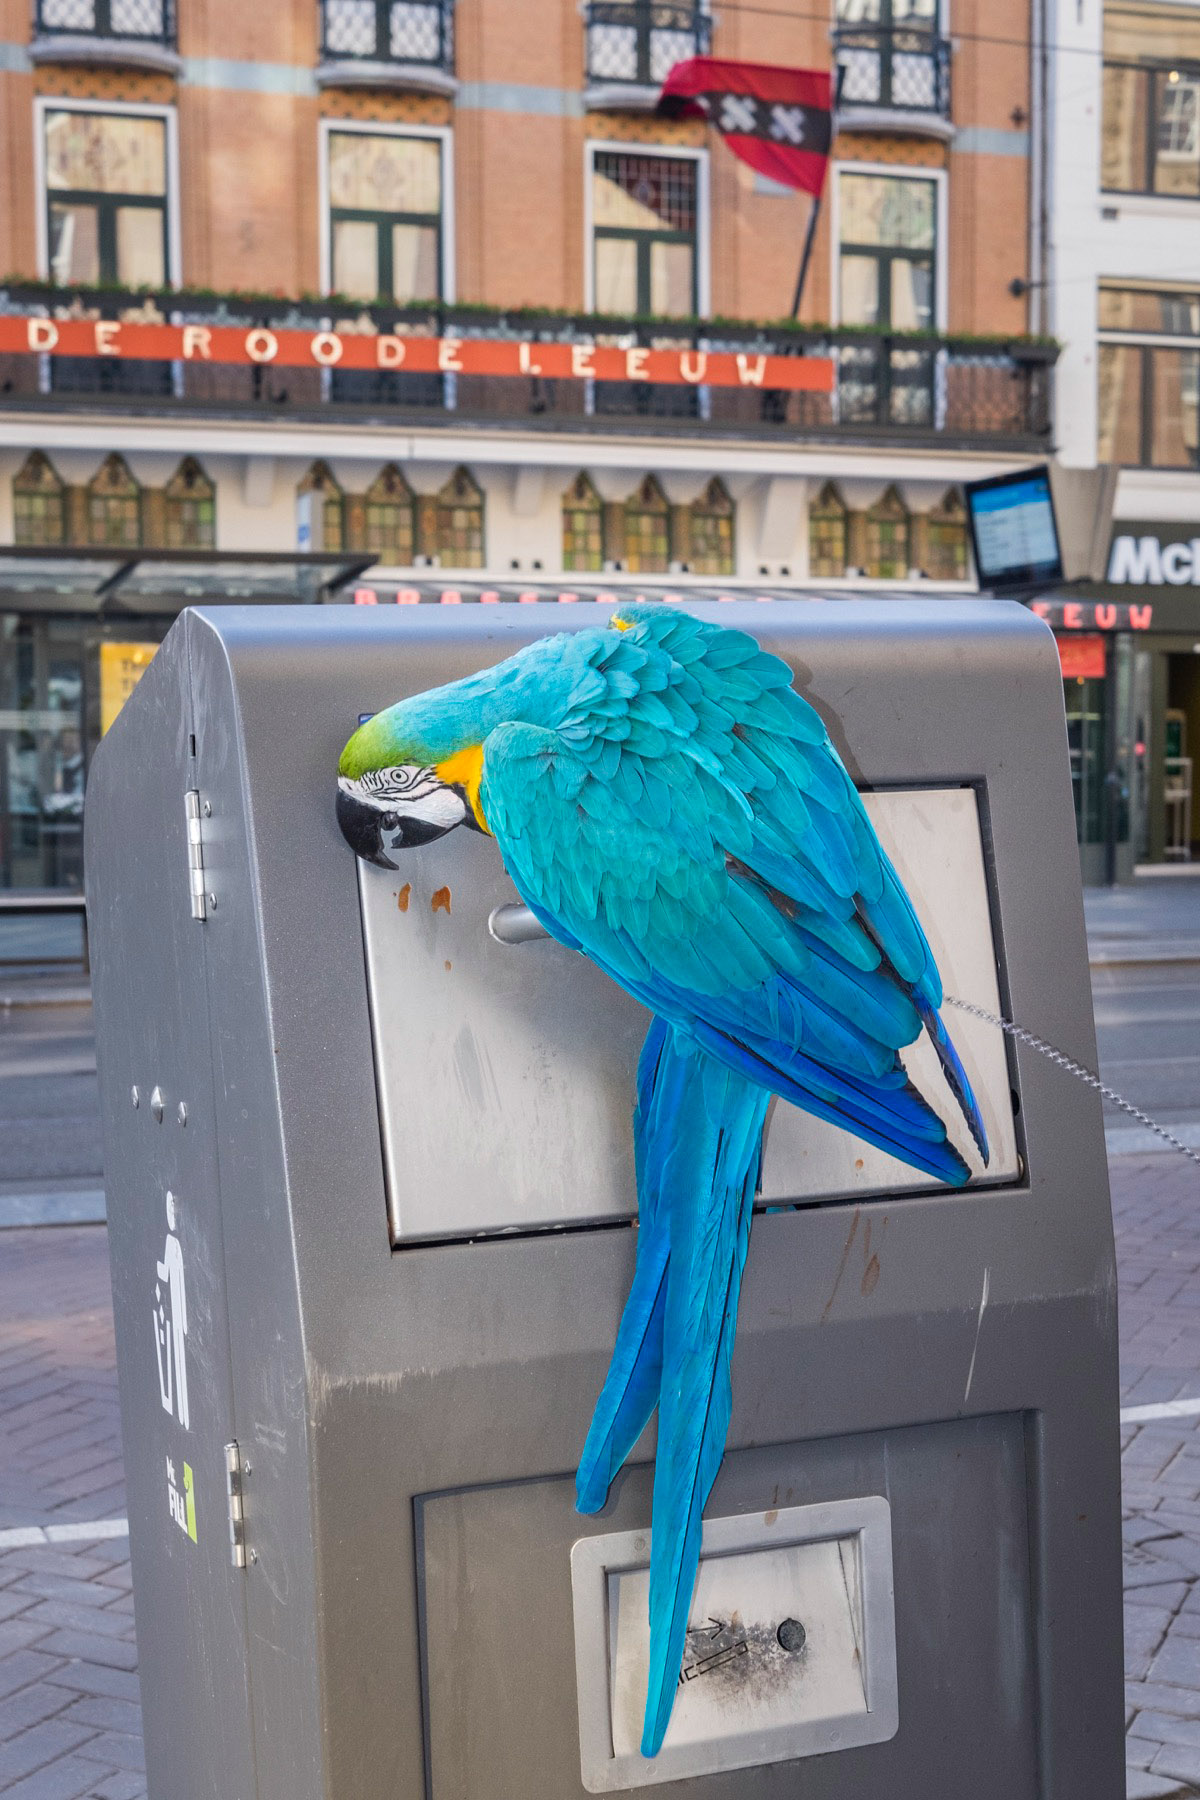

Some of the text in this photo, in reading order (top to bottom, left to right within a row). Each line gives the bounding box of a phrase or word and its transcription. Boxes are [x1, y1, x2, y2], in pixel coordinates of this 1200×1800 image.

[27, 318, 766, 385] DE ROODE LEEUW
[1107, 535, 1200, 585] Mc
